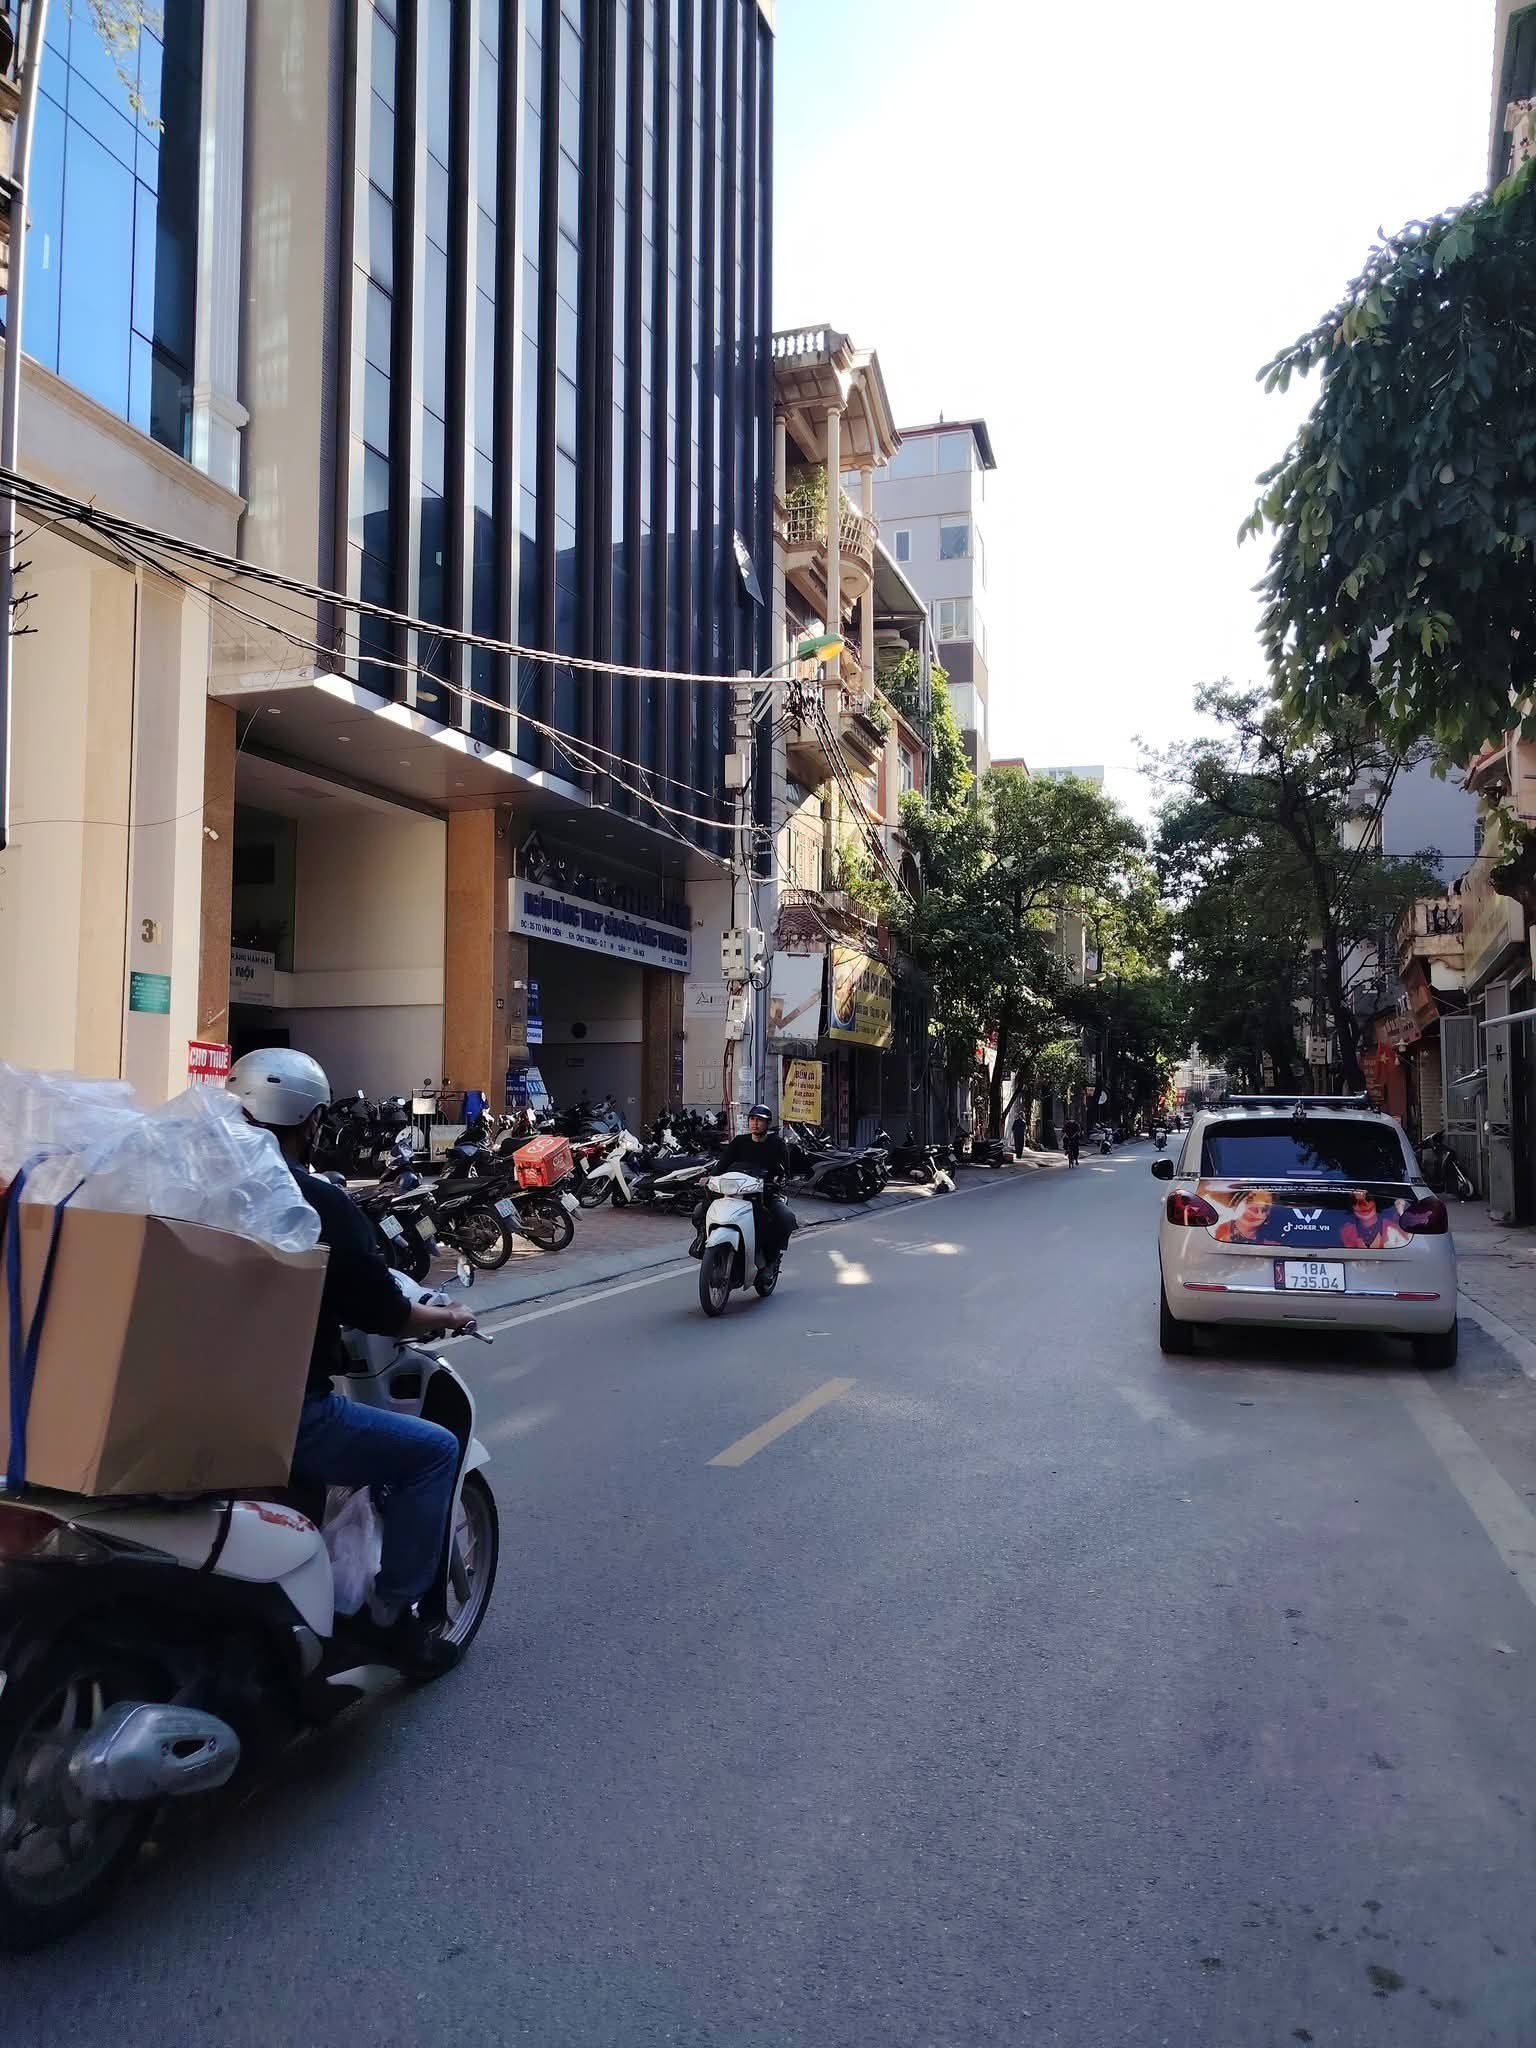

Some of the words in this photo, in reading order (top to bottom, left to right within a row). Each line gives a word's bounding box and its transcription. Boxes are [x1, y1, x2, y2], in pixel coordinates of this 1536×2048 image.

[189, 1047, 207, 1067] CHO
[1303, 1263, 1327, 1275] 18A
[1291, 1276, 1339, 1289] 735.04
